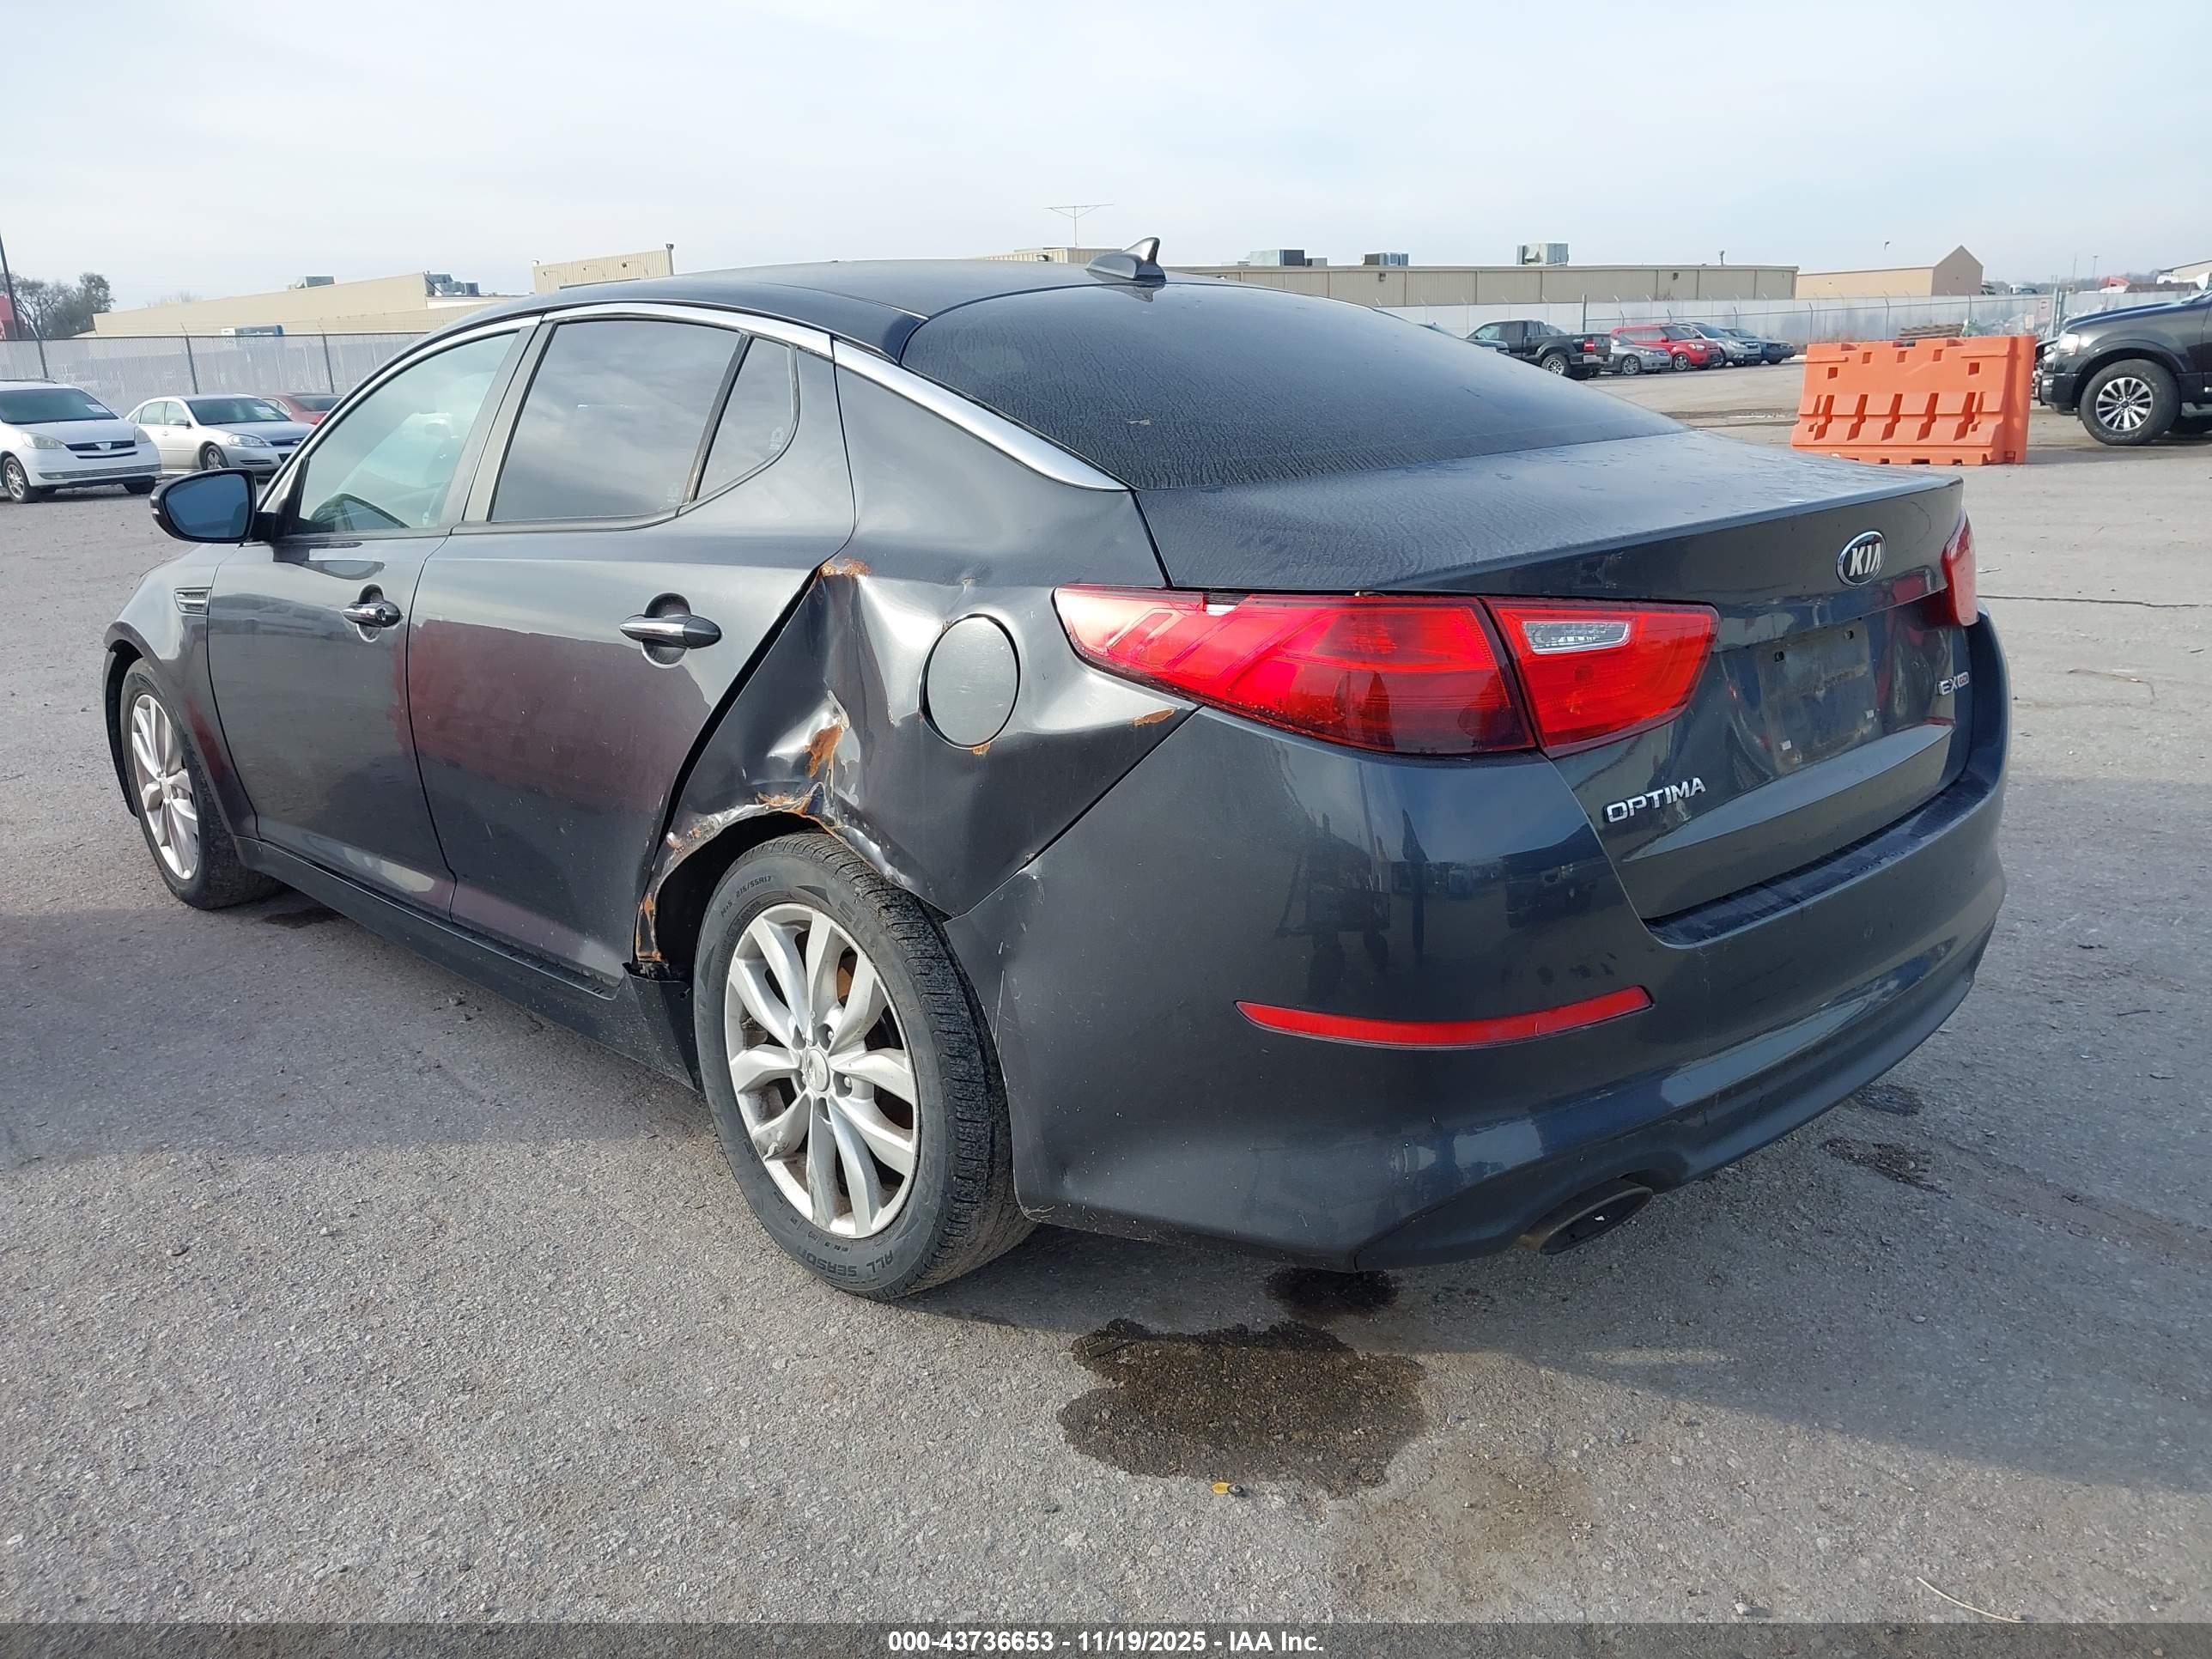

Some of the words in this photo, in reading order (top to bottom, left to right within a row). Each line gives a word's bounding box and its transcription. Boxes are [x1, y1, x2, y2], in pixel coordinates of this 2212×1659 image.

[1848, 543, 1881, 577] KIA
[1605, 776, 1707, 823] OPTIMA
[866, 1249, 894, 1273] ALL
